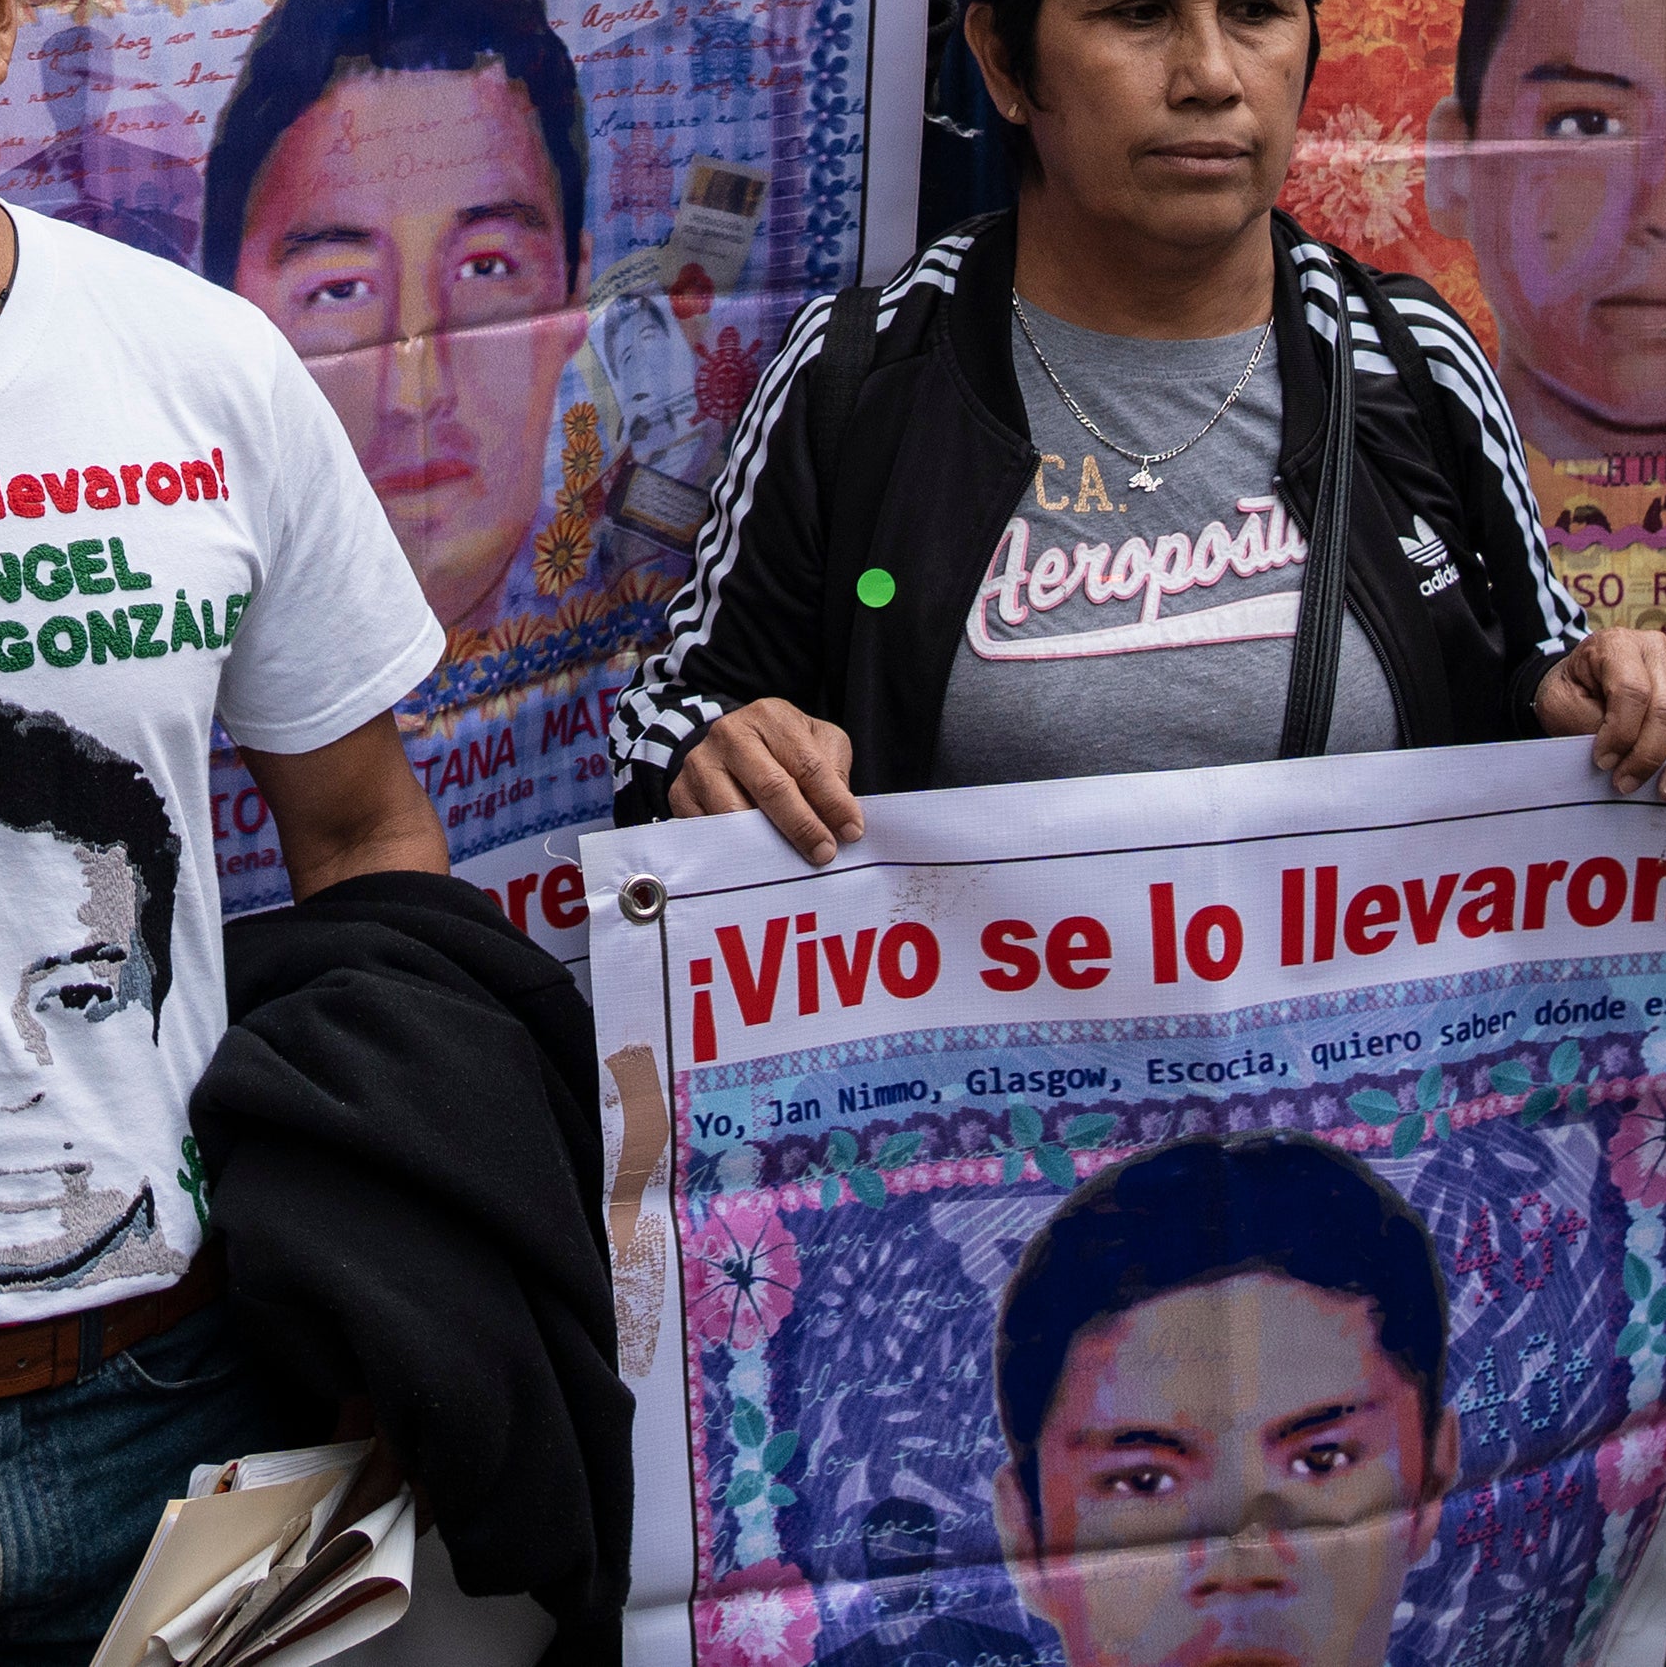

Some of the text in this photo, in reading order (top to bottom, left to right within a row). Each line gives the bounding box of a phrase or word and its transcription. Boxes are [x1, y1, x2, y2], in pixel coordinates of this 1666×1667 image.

[446, 778, 534, 828] Brígida
[690, 913, 939, 1062] ¡Vivo
[981, 917, 1111, 991] se
[1150, 884, 1242, 983] lo
[694, 1111, 747, 1139] Yo,
[769, 1097, 822, 1128] Jan
[837, 1076, 943, 1114] Nimmo,
[964, 1065, 1123, 1100] Glasgow,
[1147, 1045, 1293, 1084] Escocia,
[1310, 1027, 1423, 1070] quiero
[1439, 1006, 1518, 1047] saber
[1534, 989, 1627, 1026] dónde
